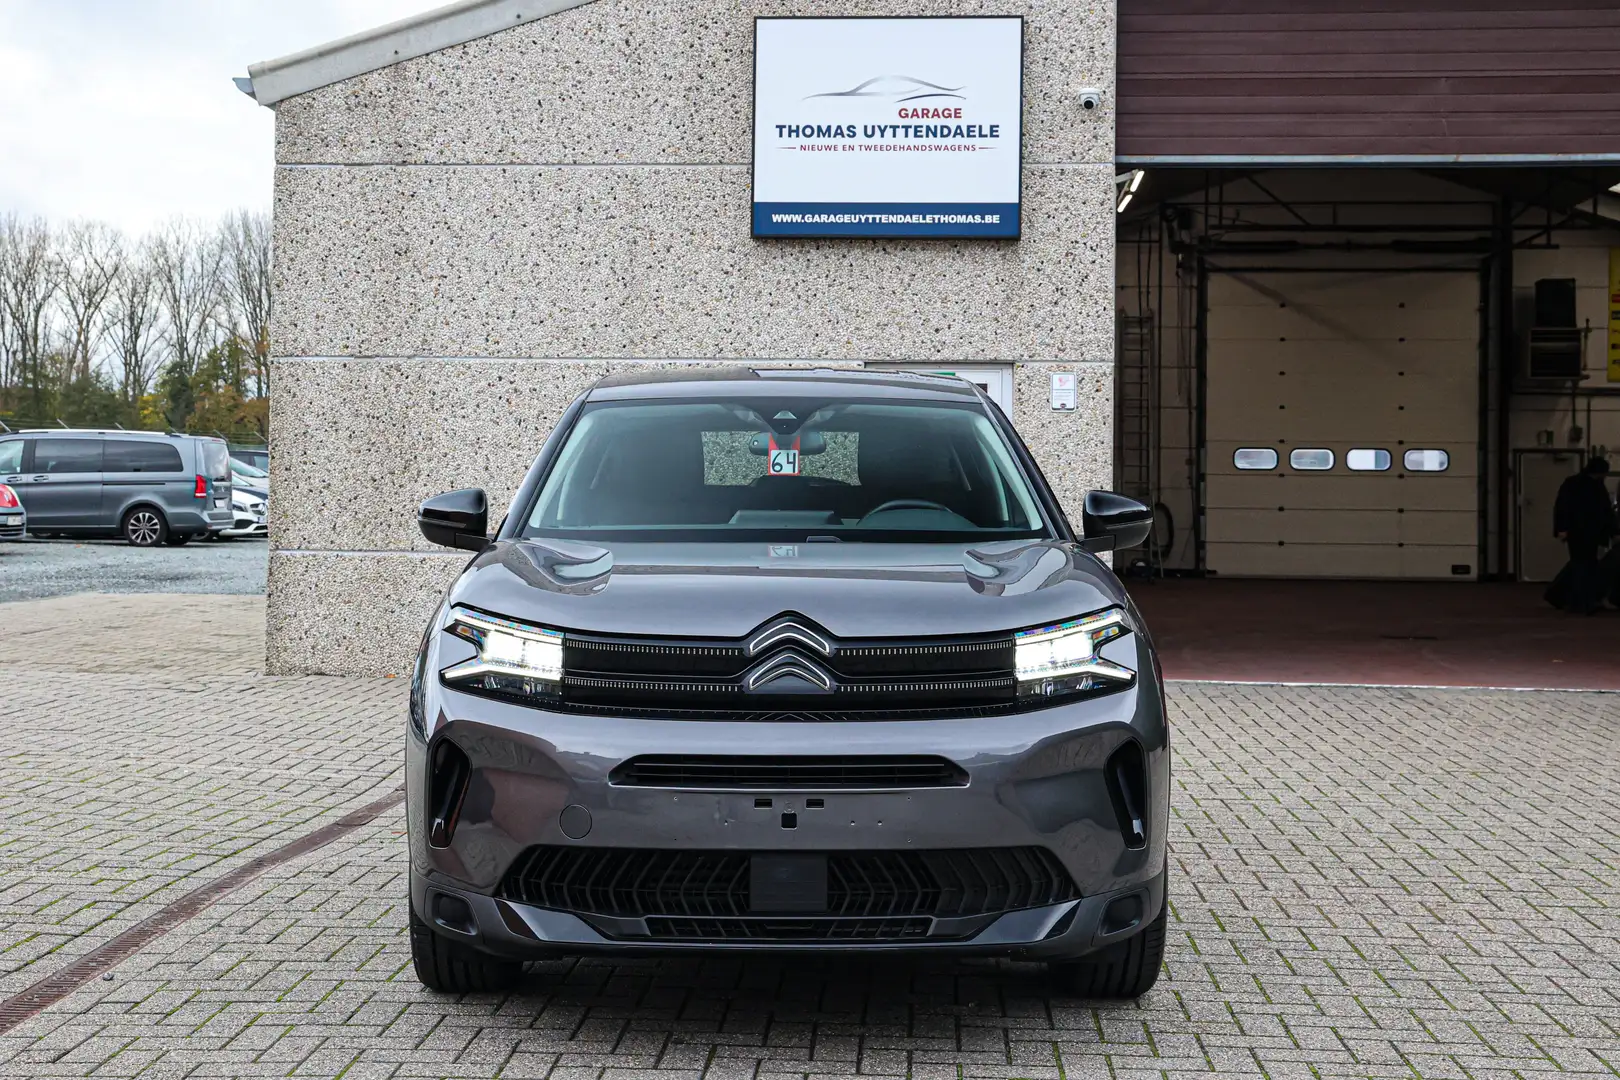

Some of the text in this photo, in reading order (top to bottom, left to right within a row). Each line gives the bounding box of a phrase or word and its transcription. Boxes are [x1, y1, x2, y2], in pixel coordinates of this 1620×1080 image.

[898, 108, 962, 119] GARAGE
[775, 124, 1000, 138] THOMAS UYTTENDAELE
[800, 144, 977, 152] NIEUWE EN TWEEDEHANDSWAGENS
[772, 213, 1000, 224] WWW.GARAGEUYTTENDAELETHOMAS.BE
[772, 452, 797, 473] 64
